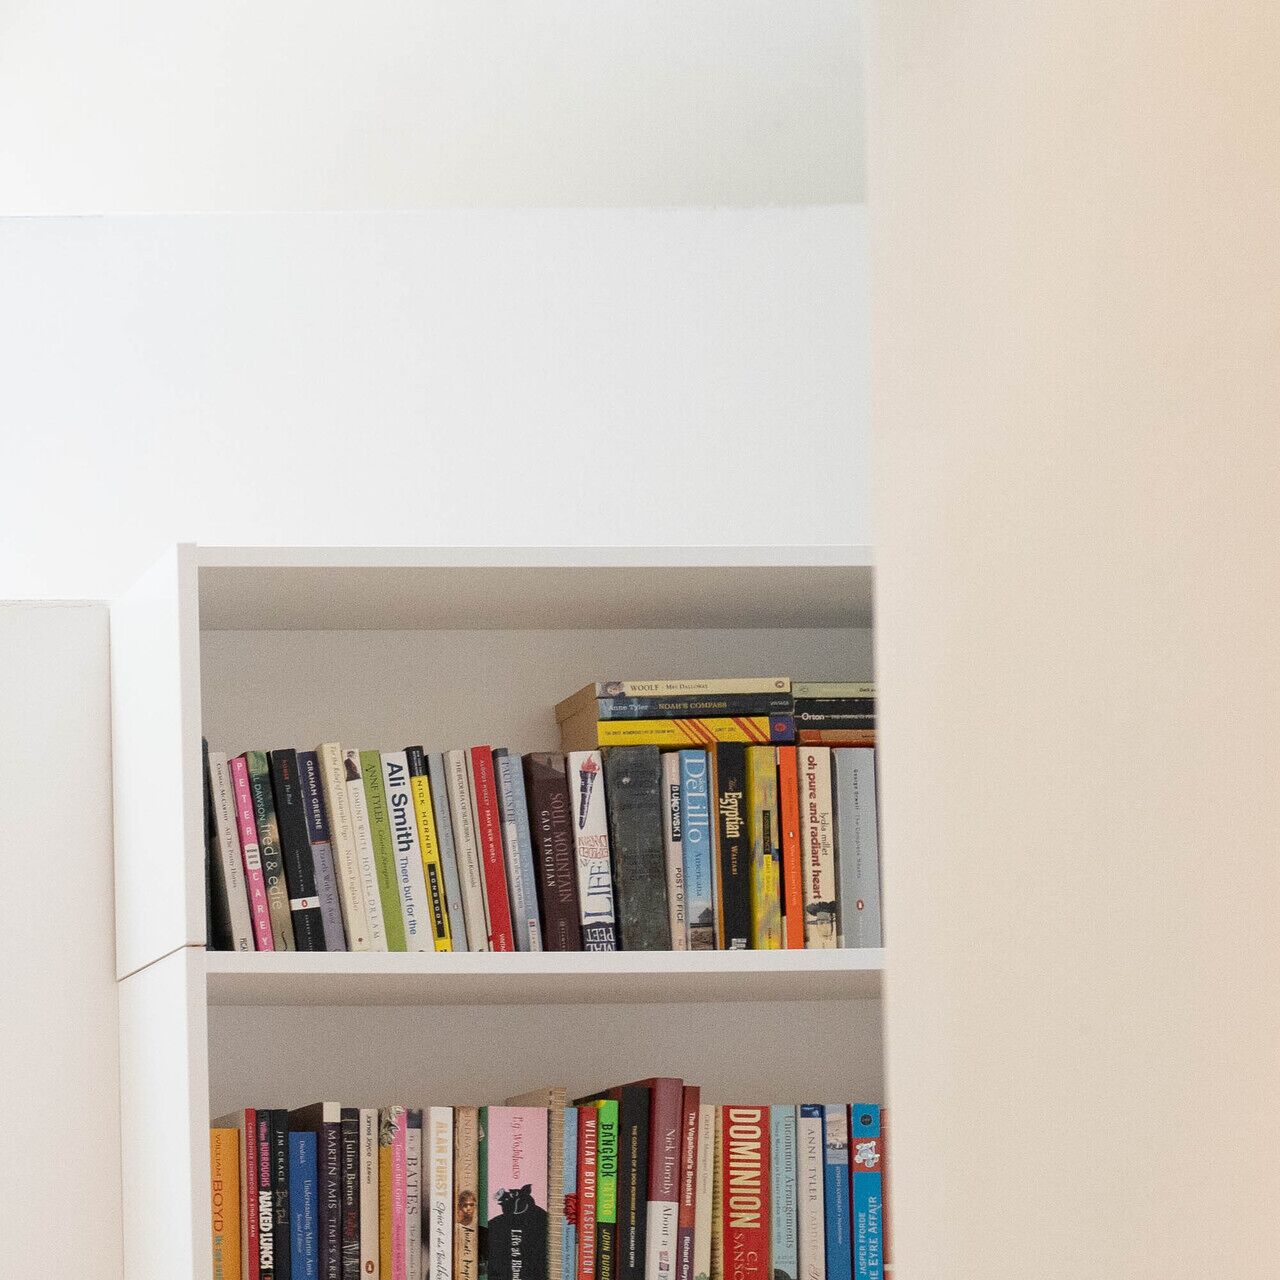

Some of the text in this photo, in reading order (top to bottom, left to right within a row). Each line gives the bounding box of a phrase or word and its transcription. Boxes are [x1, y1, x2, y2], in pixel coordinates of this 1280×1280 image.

[306, 760, 323, 830] GRAHAM GREENE
[386, 762, 403, 787] Ali
[254, 784, 265, 820] DAWSON
[392, 794, 413, 851] Smith
[685, 757, 708, 843] DeLillo
[720, 792, 744, 838] Egyptian
[820, 812, 828, 831] lydia
[260, 824, 275, 855] fred
[421, 812, 432, 855] HORNBY
[542, 811, 555, 887] GAO XINGJIAN
[550, 793, 572, 902] SOUL MOUNTAIN
[807, 756, 822, 899] oh pure and radiant heart
[237, 763, 268, 945] PETER CAREY
[267, 862, 277, 872] &
[399, 856, 410, 884] There
[268, 876, 283, 909] edie
[406, 904, 415, 918] for
[584, 861, 612, 918] LIFE
[408, 920, 417, 935] the
[328, 1130, 337, 1175] MARTIN
[599, 1122, 615, 1178] BANGKOK
[686, 1127, 695, 1169] Vagabond's
[729, 1108, 761, 1228] DOMINION
[808, 1129, 817, 1201] ANNE TYLER
[345, 1138, 355, 1206] Julian Barnes
[407, 1157, 417, 1216] BATES
[661, 1128, 675, 1236] Nick Hornby About
[685, 1171, 693, 1206] Breakfast
[784, 1115, 794, 1249] Uncommon Arrangements
[259, 1142, 273, 1269] BURROUGHS NAKED LUNCH
[328, 1181, 337, 1209] AMIS
[583, 1120, 596, 1274] WILLIAM BOYD FASCINATION
[869, 1196, 882, 1233] AFFAIR
[511, 1229, 521, 1246] Life
[602, 1229, 610, 1252] JOHN
[869, 1237, 878, 1266] EYRE
[746, 1252, 757, 1274] C.J.
